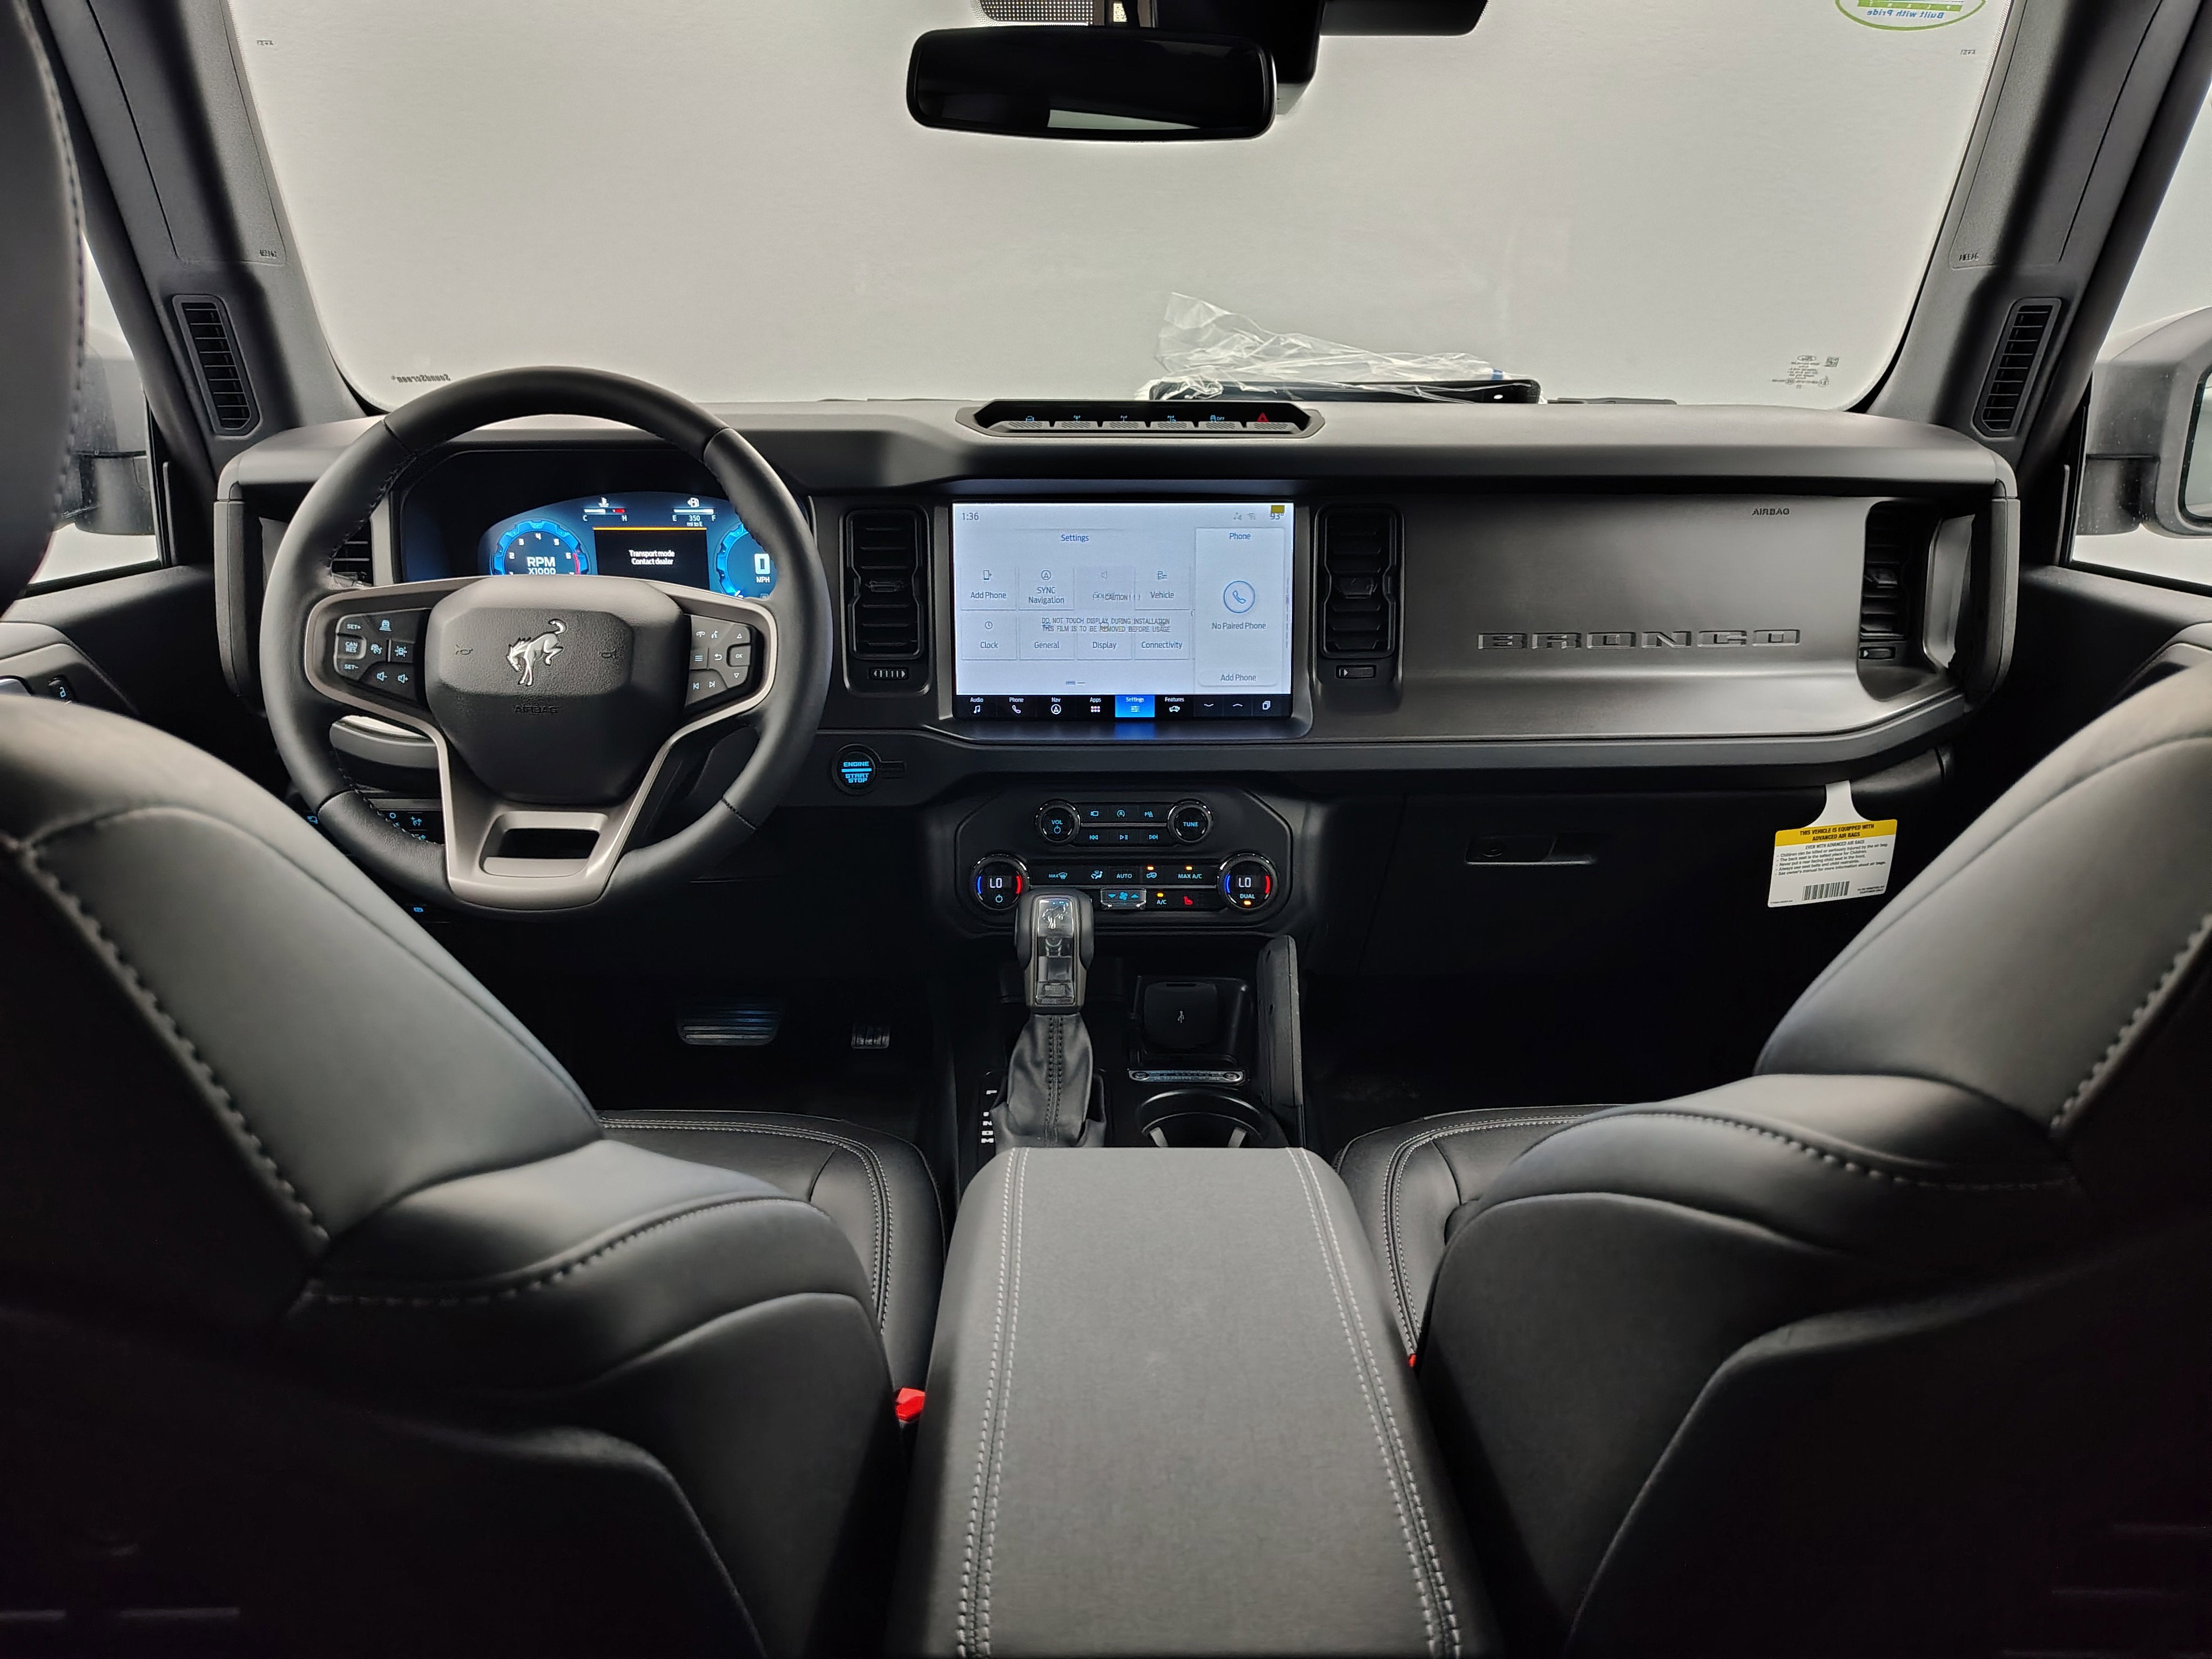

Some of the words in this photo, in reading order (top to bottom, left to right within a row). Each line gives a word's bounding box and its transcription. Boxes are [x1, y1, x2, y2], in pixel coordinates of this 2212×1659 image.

[962, 512, 979, 521] 1:36
[1752, 508, 1790, 516] AIRBAG
[1061, 534, 1089, 542] Settings
[527, 557, 556, 567] RPM
[754, 553, 771, 575] 0
[1028, 596, 1064, 605] Navigation
[1478, 629, 1801, 650] BRONCO
[1092, 642, 1117, 650] Display
[1142, 642, 1183, 650] Connectivity
[989, 878, 1003, 888] LO
[1238, 877, 1251, 887] LO
